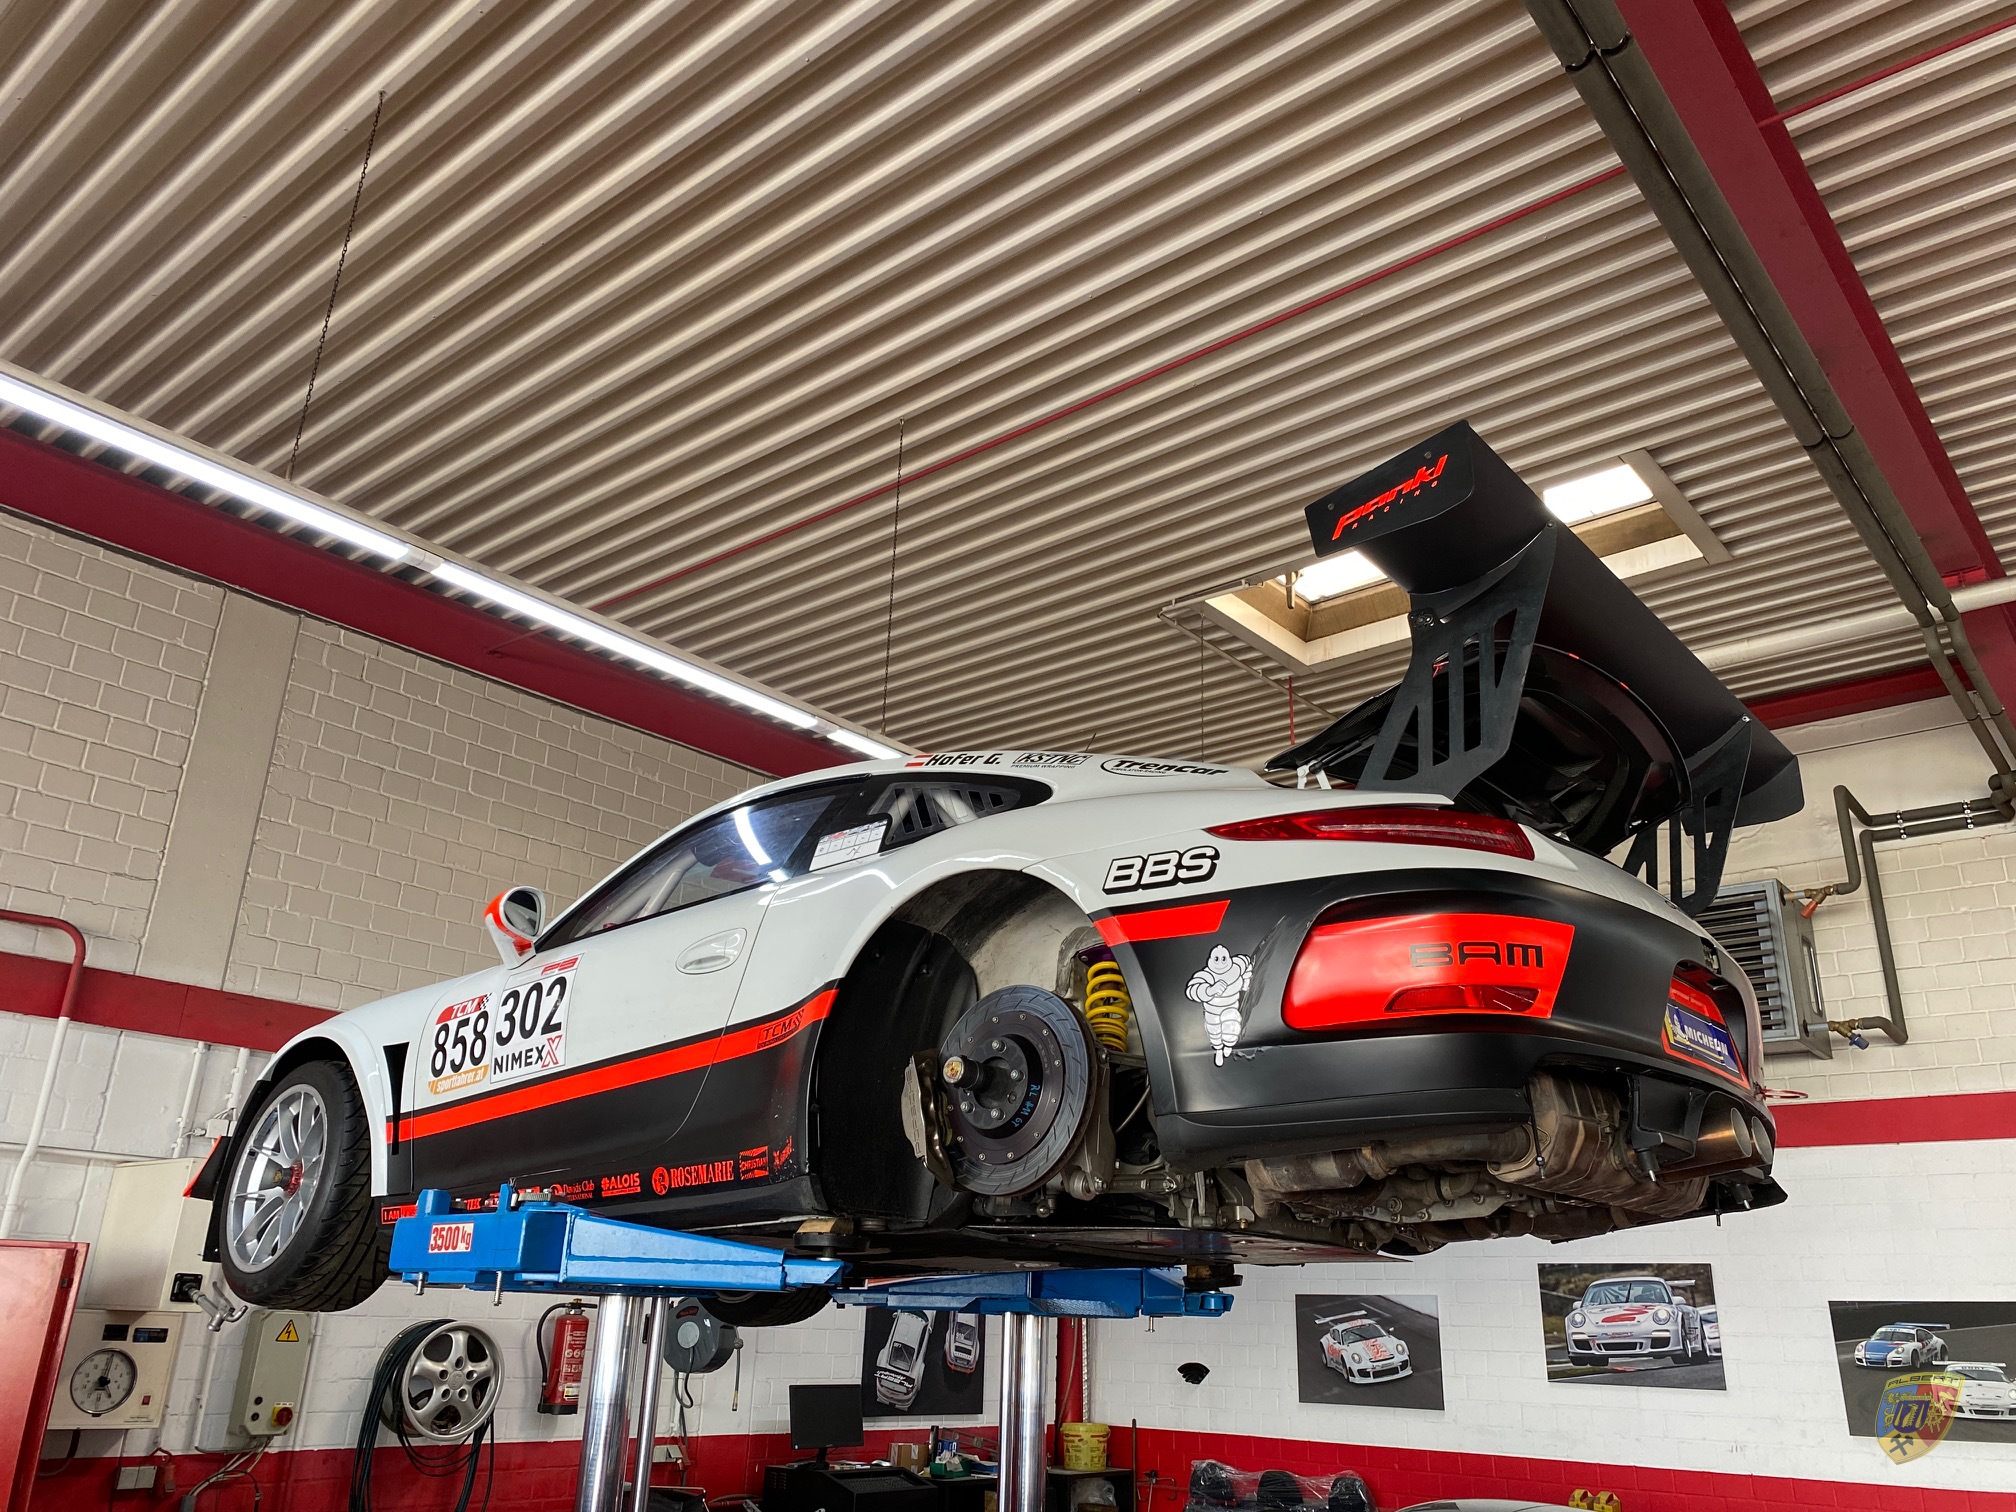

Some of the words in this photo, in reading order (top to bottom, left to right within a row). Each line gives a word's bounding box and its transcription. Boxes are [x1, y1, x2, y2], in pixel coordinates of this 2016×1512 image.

[924, 753, 983, 767] Hofer
[982, 753, 1003, 765] G.
[1113, 760, 1230, 775] Trencar
[1102, 846, 1220, 895] BBS
[1410, 941, 1544, 968] BAM
[450, 998, 478, 1020] TCM
[495, 976, 567, 1047] 302
[430, 1010, 490, 1078] 858
[1684, 1025, 1728, 1056] MICHELIN
[436, 1068, 485, 1092] sportfahrer.at
[601, 1172, 640, 1191] #ALOIS
[669, 1160, 735, 1188] ROSEMARIE
[429, 1225, 460, 1252] 3500
[460, 1226, 472, 1251] kg
